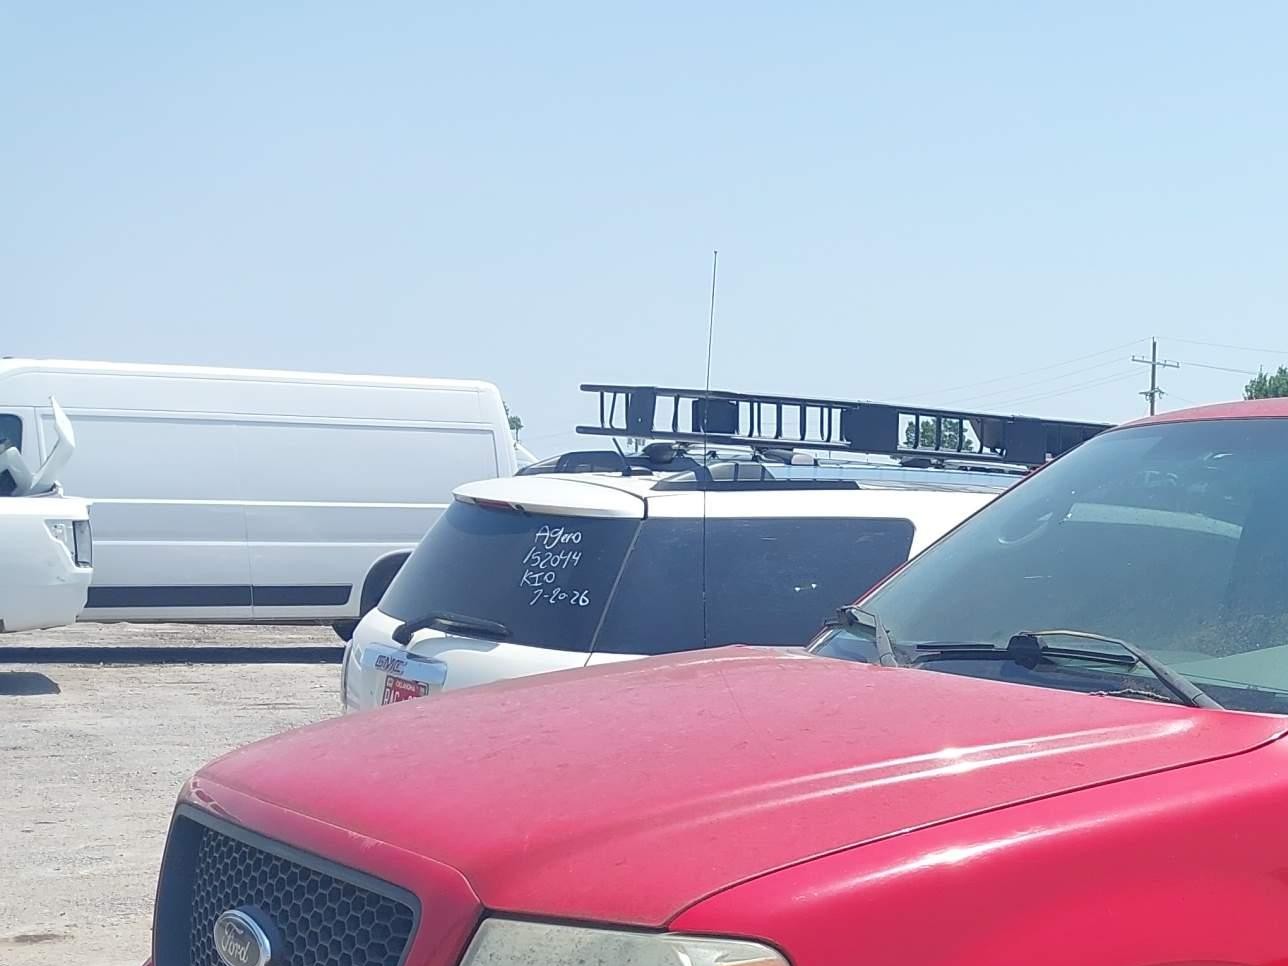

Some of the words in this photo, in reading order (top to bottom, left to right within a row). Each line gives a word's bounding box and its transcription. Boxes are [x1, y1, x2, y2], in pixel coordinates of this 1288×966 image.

[534, 525, 582, 549] Agero
[522, 546, 582, 569] 152044
[375, 655, 408, 675] GMC
[221, 922, 251, 964] Ford
